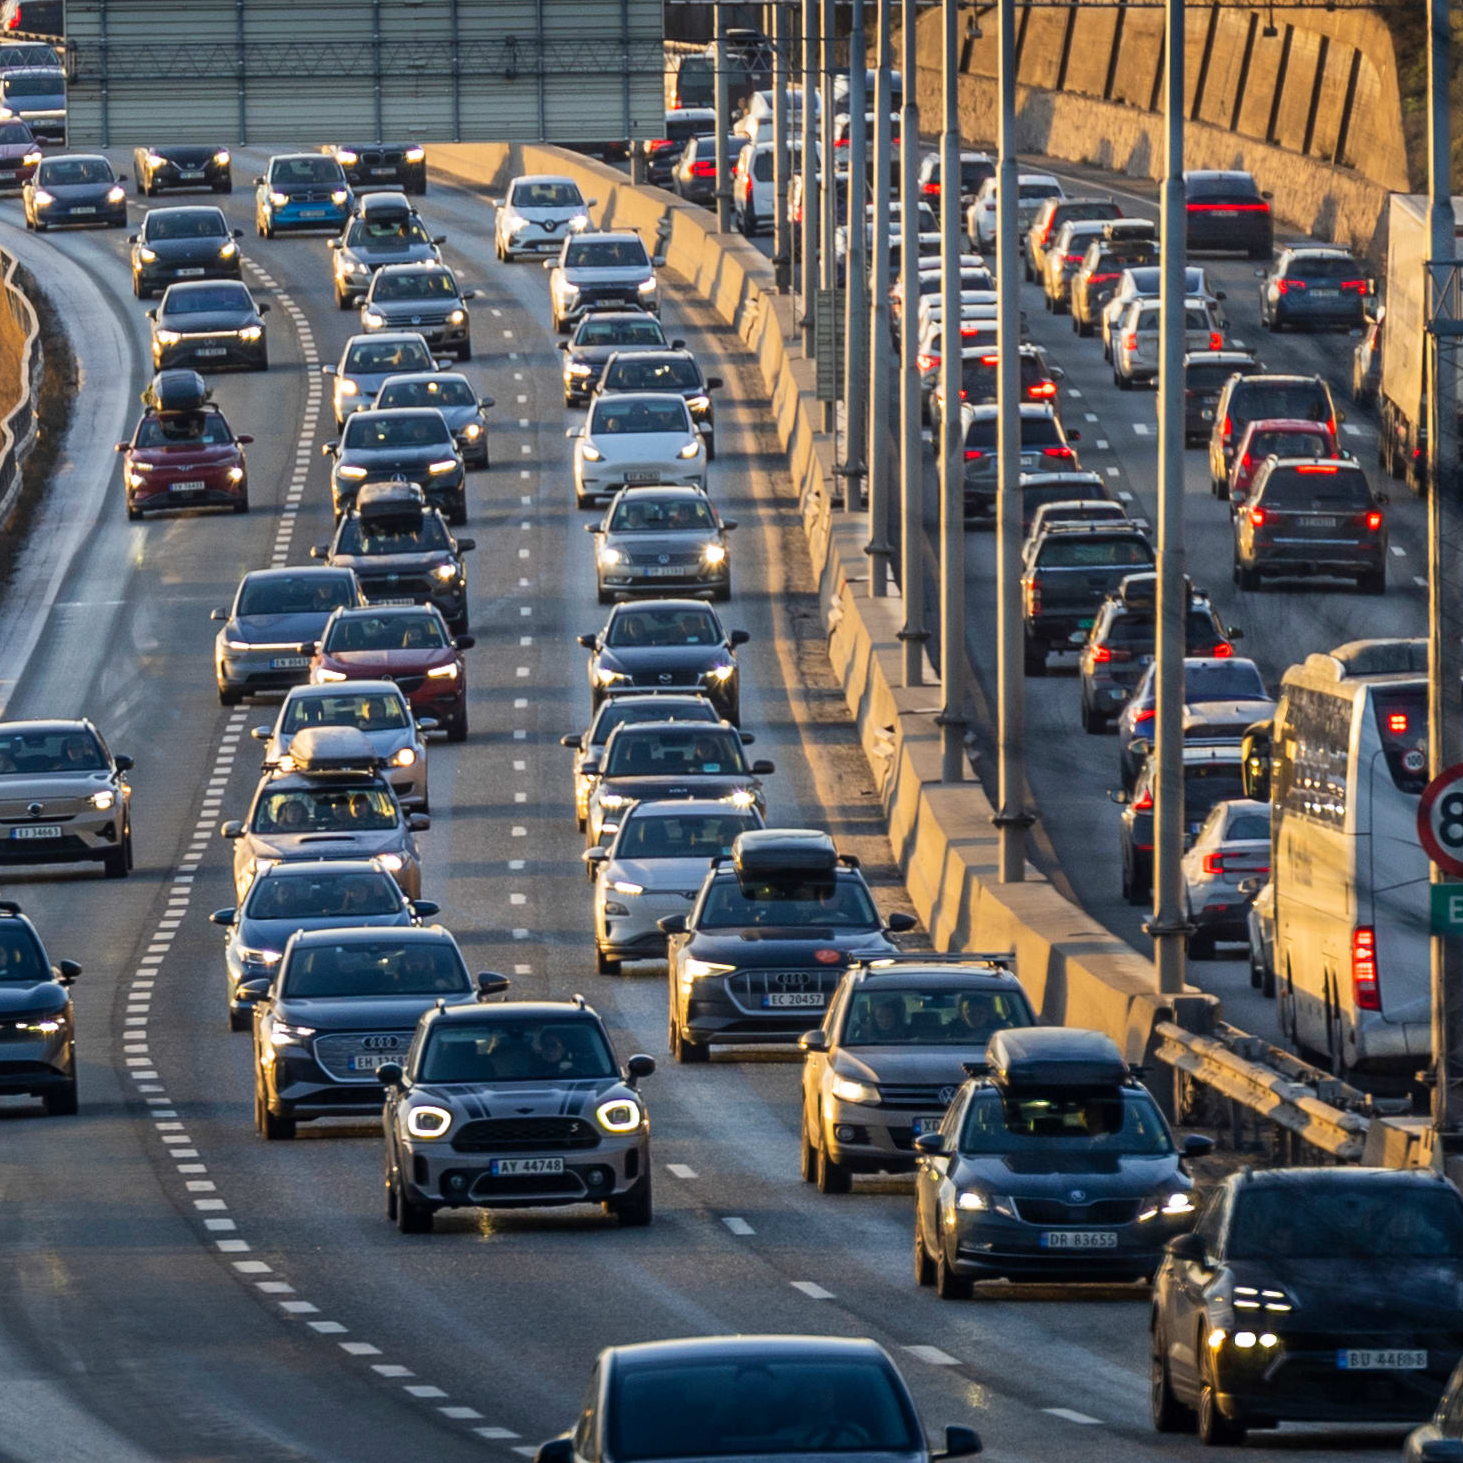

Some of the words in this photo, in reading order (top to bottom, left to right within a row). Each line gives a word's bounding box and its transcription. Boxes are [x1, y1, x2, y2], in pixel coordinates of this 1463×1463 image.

[772, 994, 785, 1005] EC
[358, 1056, 373, 1069] EH
[501, 1160, 518, 1174] AY
[522, 1158, 563, 1173] 44748
